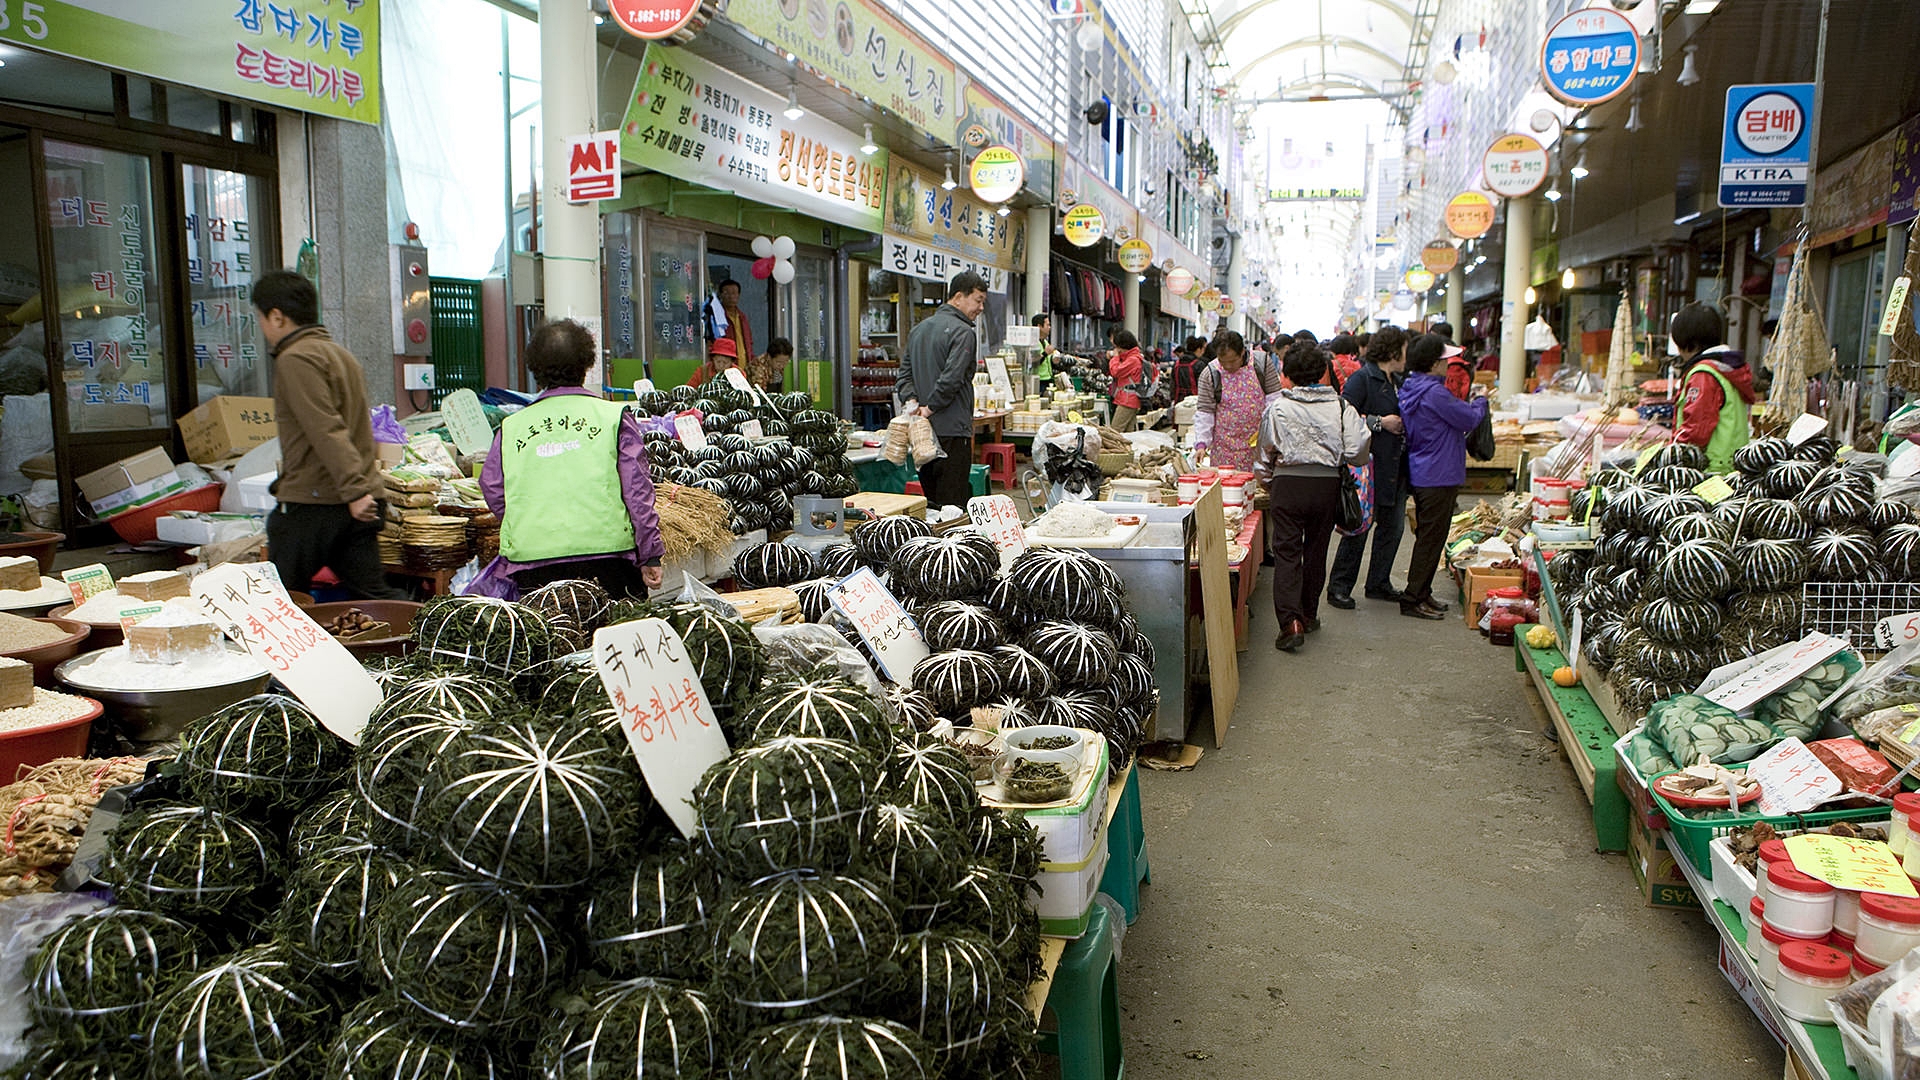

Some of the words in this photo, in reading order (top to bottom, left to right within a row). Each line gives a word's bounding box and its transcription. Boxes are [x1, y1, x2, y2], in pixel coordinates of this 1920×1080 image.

[233, 0, 363, 58] 감자가루
[235, 42, 364, 107] 도토리가루
[1550, 46, 1632, 73] 종합마트
[660, 63, 695, 96] 부치기
[748, 105, 773, 131] 동동주
[1745, 109, 1796, 133] 담배
[570, 140, 617, 200] 쌀
[641, 125, 706, 163] 수제메밀묵
[745, 134, 770, 157] 막걸리
[777, 128, 885, 210] 정선향토음식점
[1735, 168, 1793, 180] KTRA
[924, 187, 953, 230] 정선
[957, 203, 1009, 249] 신토불이
[185, 213, 211, 368] 메밀가루
[207, 217, 235, 368] 감자가루
[232, 219, 258, 368] 도토리가루
[84, 382, 150, 405] 도·소매
[969, 502, 991, 526] 정선
[199, 570, 272, 622] 국내산
[604, 623, 680, 689] 국내산
